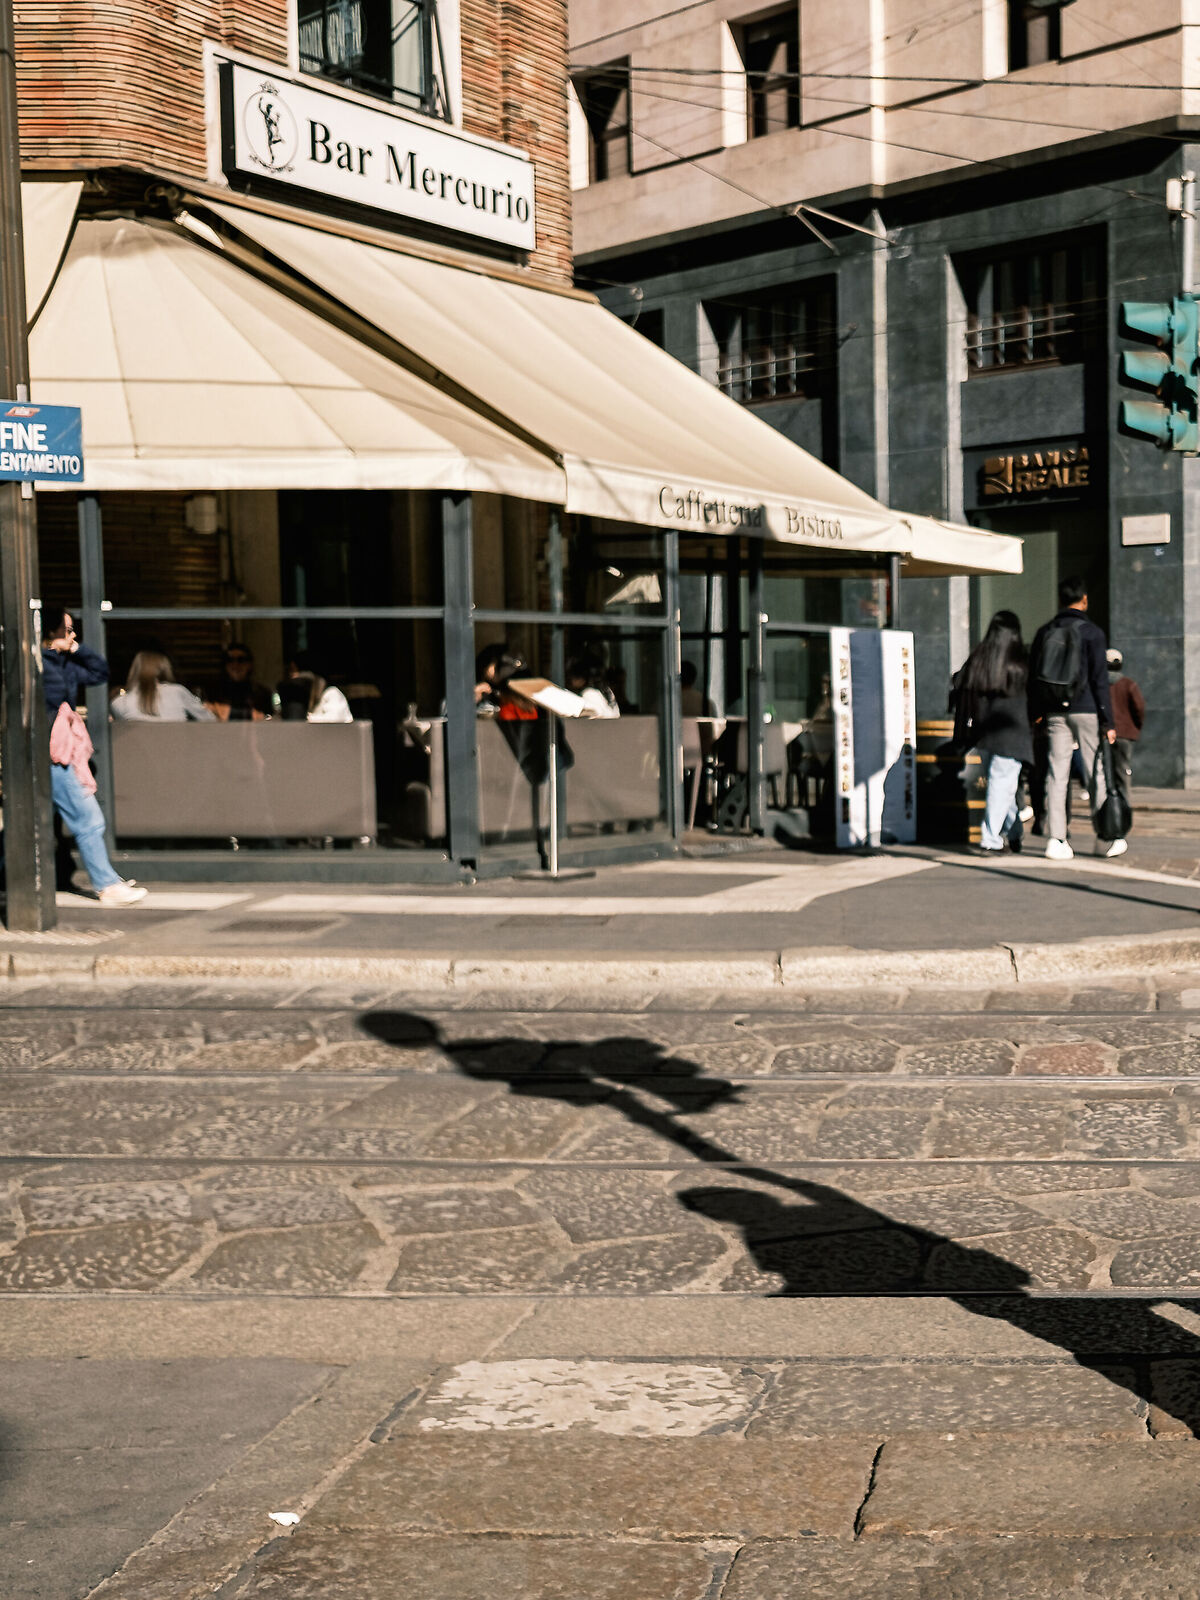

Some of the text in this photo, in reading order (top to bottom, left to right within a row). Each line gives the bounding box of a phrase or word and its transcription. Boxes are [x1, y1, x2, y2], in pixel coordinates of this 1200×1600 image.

[308, 119, 530, 224] Bar Mercurio
[0, 421, 48, 452] FINE
[0, 451, 81, 475] ENTAMENTO
[1016, 465, 1090, 493] REALE
